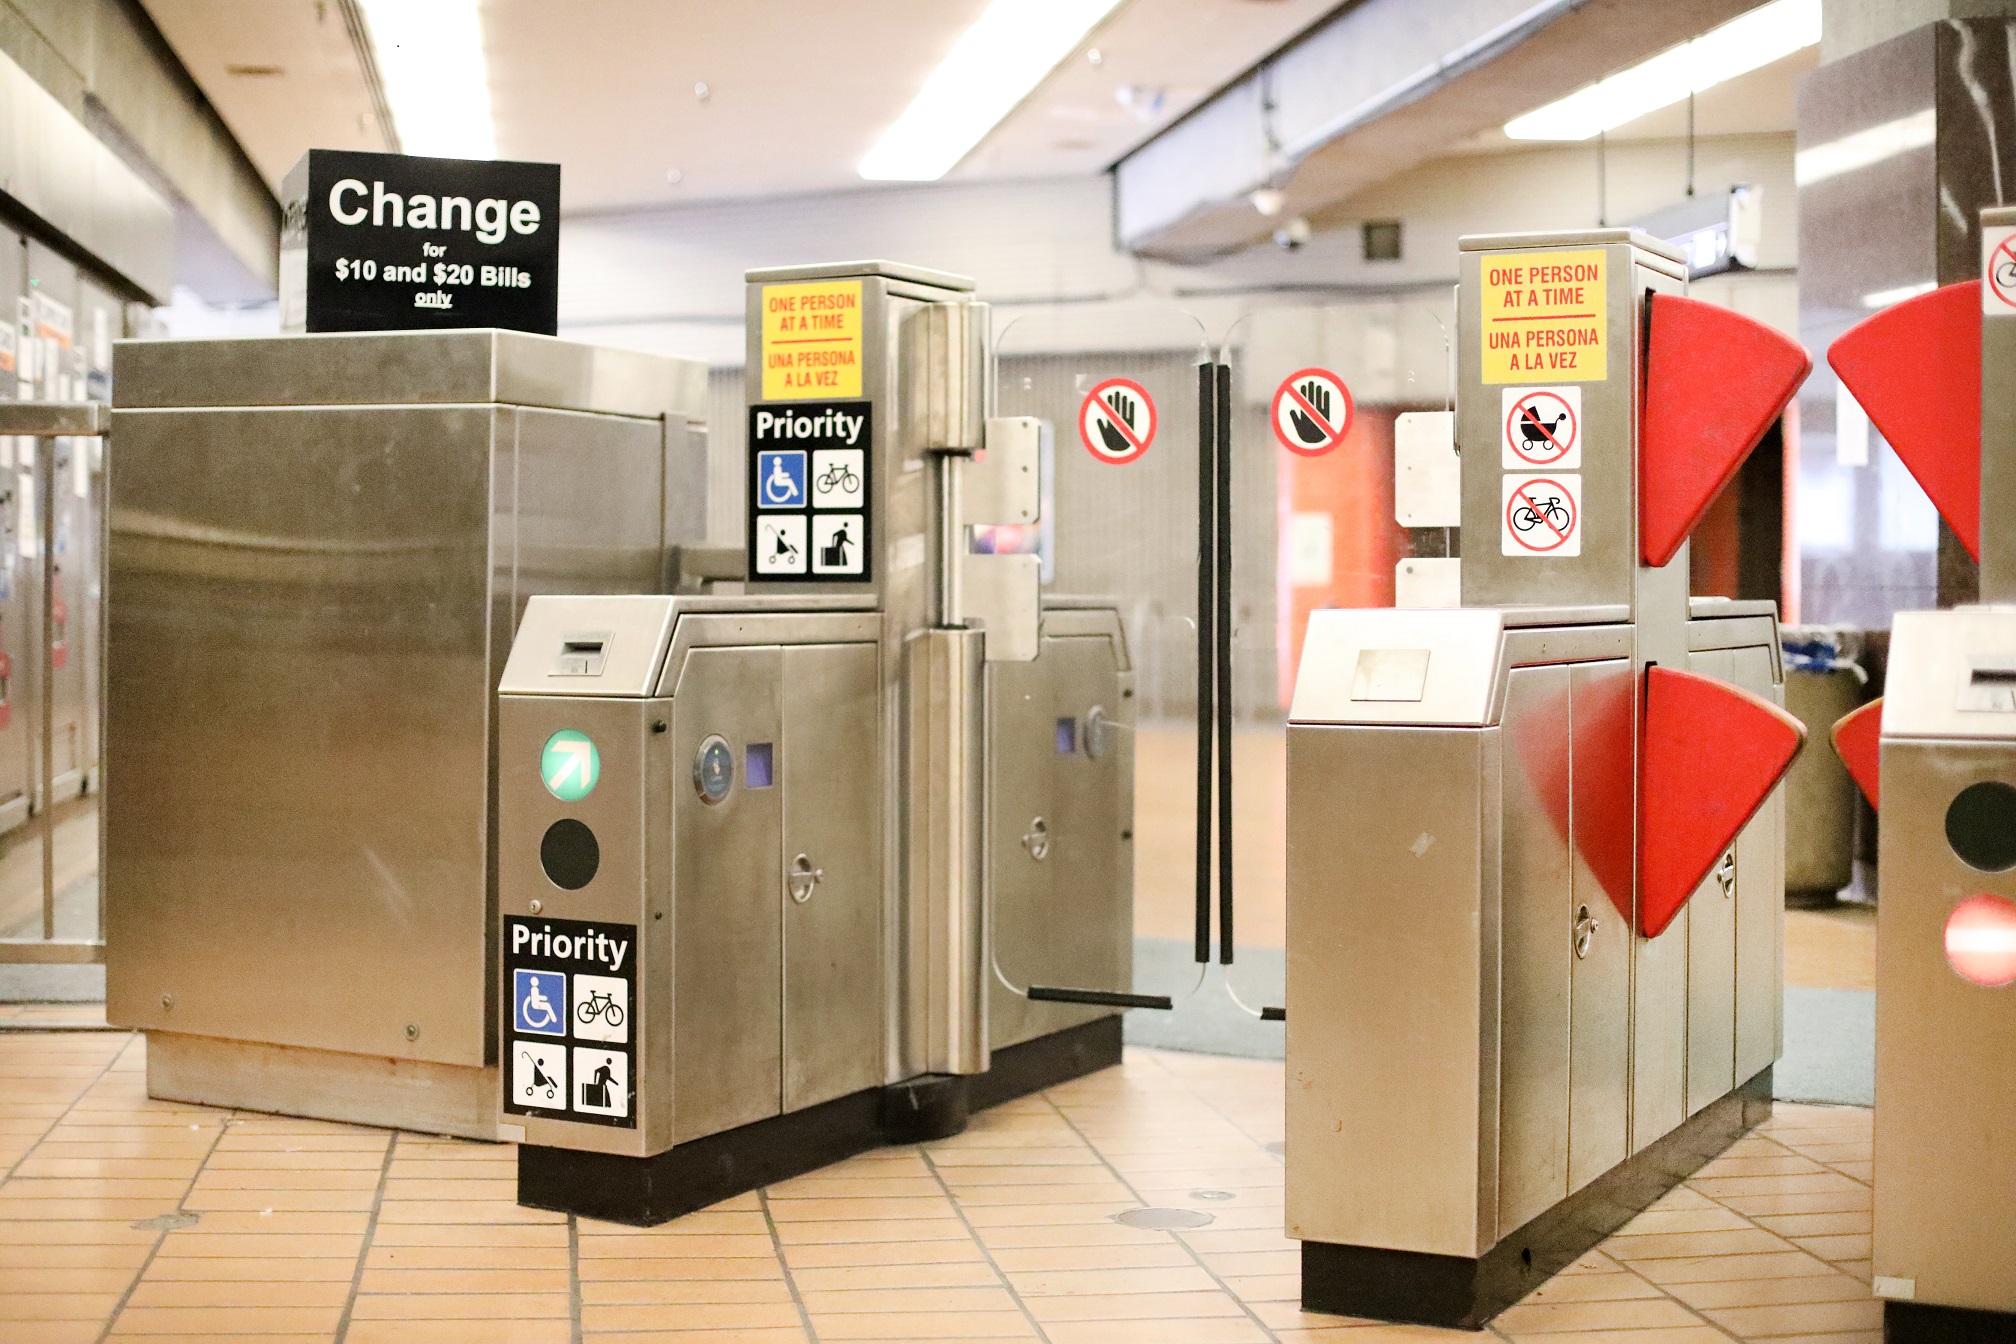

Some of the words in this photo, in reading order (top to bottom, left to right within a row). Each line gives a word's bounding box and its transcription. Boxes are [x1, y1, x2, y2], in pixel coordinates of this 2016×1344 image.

[329, 178, 541, 245] Change
[423, 242, 447, 257] for
[335, 257, 377, 281] $10
[383, 263, 427, 283] and
[433, 262, 474, 286] $20
[481, 265, 531, 288] Bills
[1489, 268, 1523, 287] ONE
[1529, 264, 1598, 284] PERSON
[414, 290, 453, 309] only
[769, 296, 796, 313] ONE
[800, 293, 856, 311] PERSON
[1503, 290, 1523, 308] AT
[1527, 289, 1539, 307] A
[1543, 287, 1584, 306] TIME
[780, 316, 795, 332] AT
[799, 316, 808, 331] A
[812, 314, 844, 330] TIME
[1489, 332, 1521, 350] UNA
[1526, 328, 1599, 348] PERSONA
[768, 352, 793, 369] UNA
[797, 350, 856, 367] PERSONA
[1509, 353, 1520, 371] A
[1525, 352, 1544, 370] LA
[1549, 351, 1577, 369] VEZ
[785, 372, 793, 388] A
[797, 372, 812, 387] LA
[815, 370, 838, 387] VEZ
[756, 408, 864, 445] Priority
[512, 923, 629, 972] Priority
